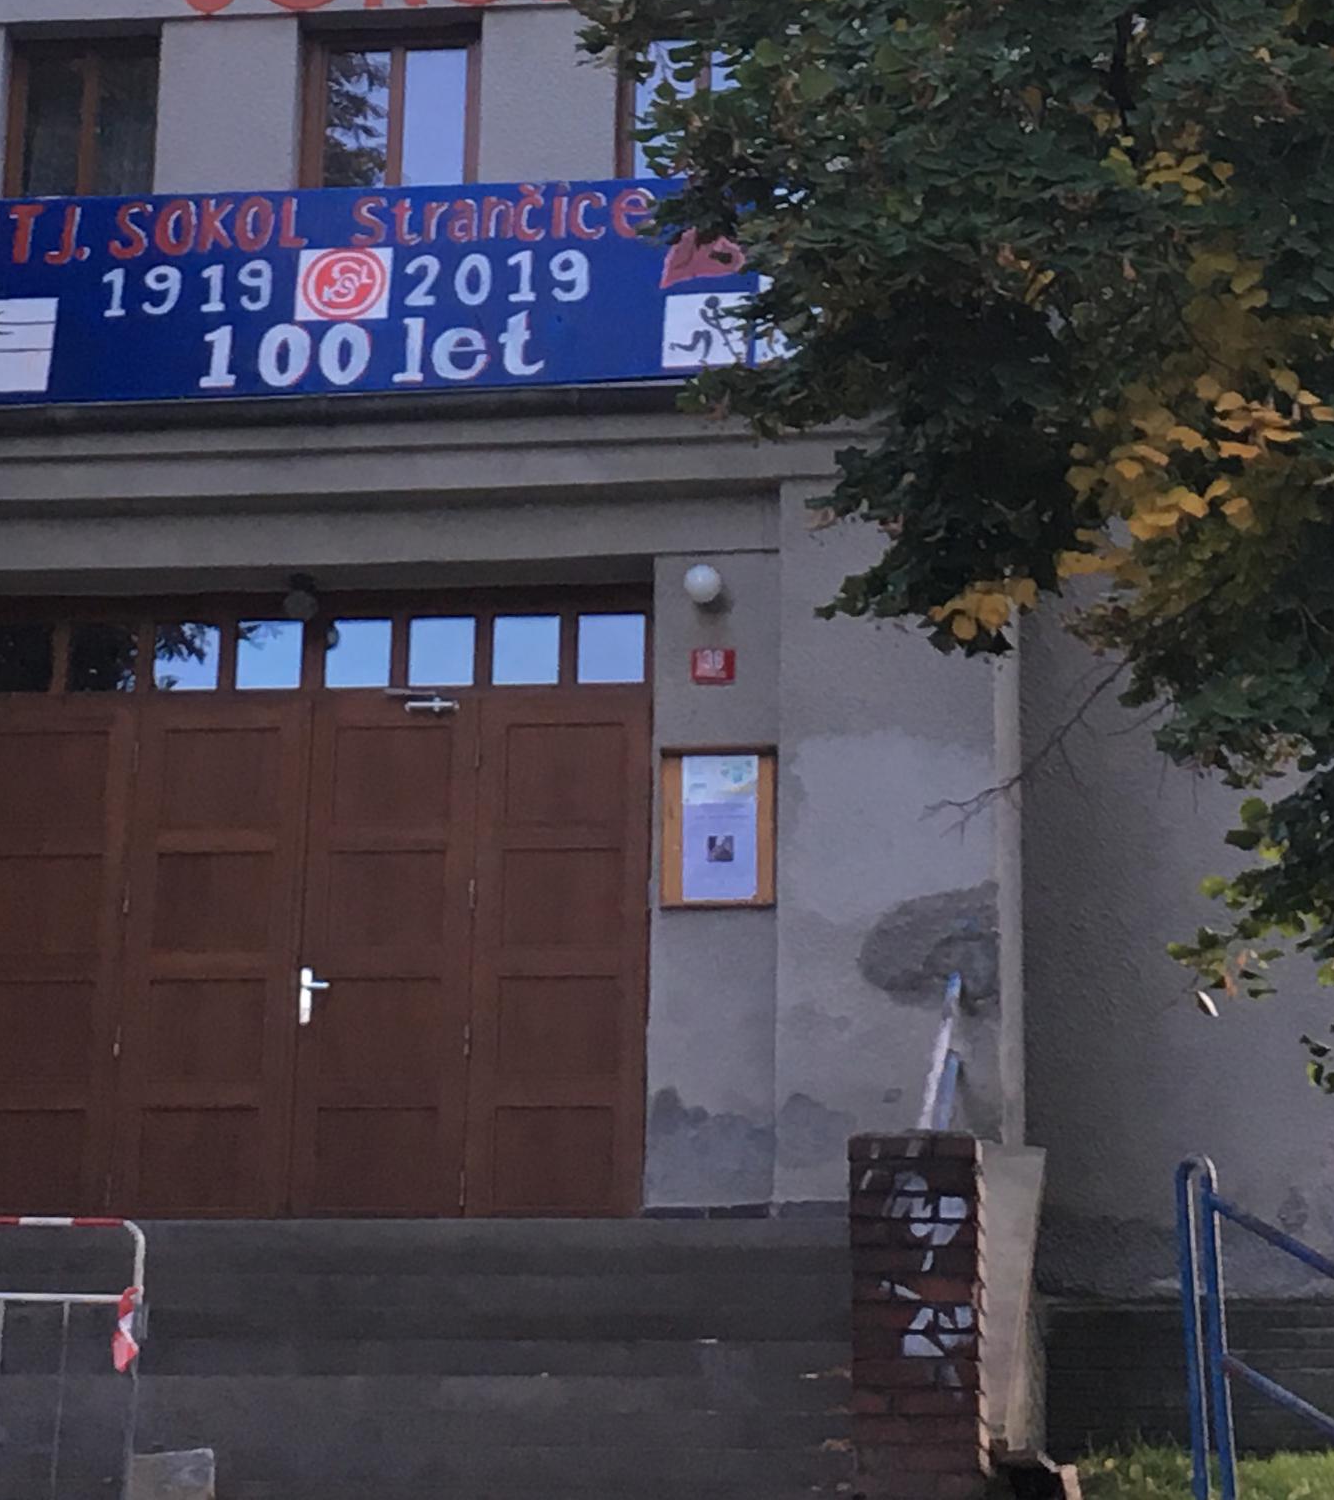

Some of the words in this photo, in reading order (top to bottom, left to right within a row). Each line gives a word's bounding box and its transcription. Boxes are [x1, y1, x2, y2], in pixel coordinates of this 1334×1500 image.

[108, 196, 307, 258] SOKOL
[351, 183, 657, 247] Strančice
[101, 260, 273, 317] 1919
[403, 249, 591, 307] 2019
[198, 321, 372, 389] 100
[392, 310, 545, 383] let
